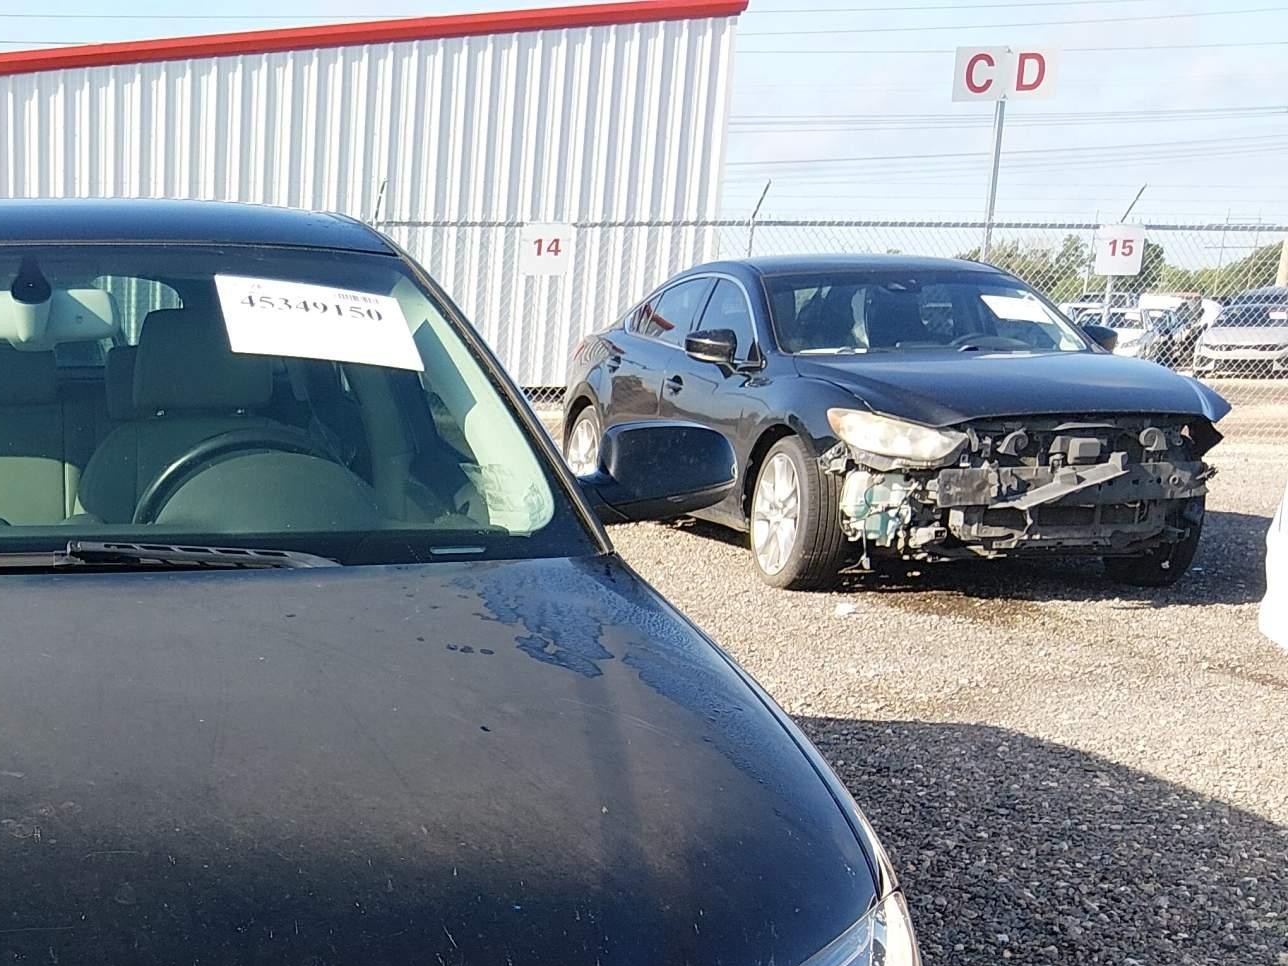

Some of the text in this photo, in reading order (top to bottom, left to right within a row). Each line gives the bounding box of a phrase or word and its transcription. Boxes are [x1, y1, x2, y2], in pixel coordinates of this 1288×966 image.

[965, 53, 995, 94] C
[1015, 52, 1046, 92] D
[534, 238, 561, 256] 14
[1109, 239, 1134, 257] 15
[240, 294, 383, 322] 45349150
